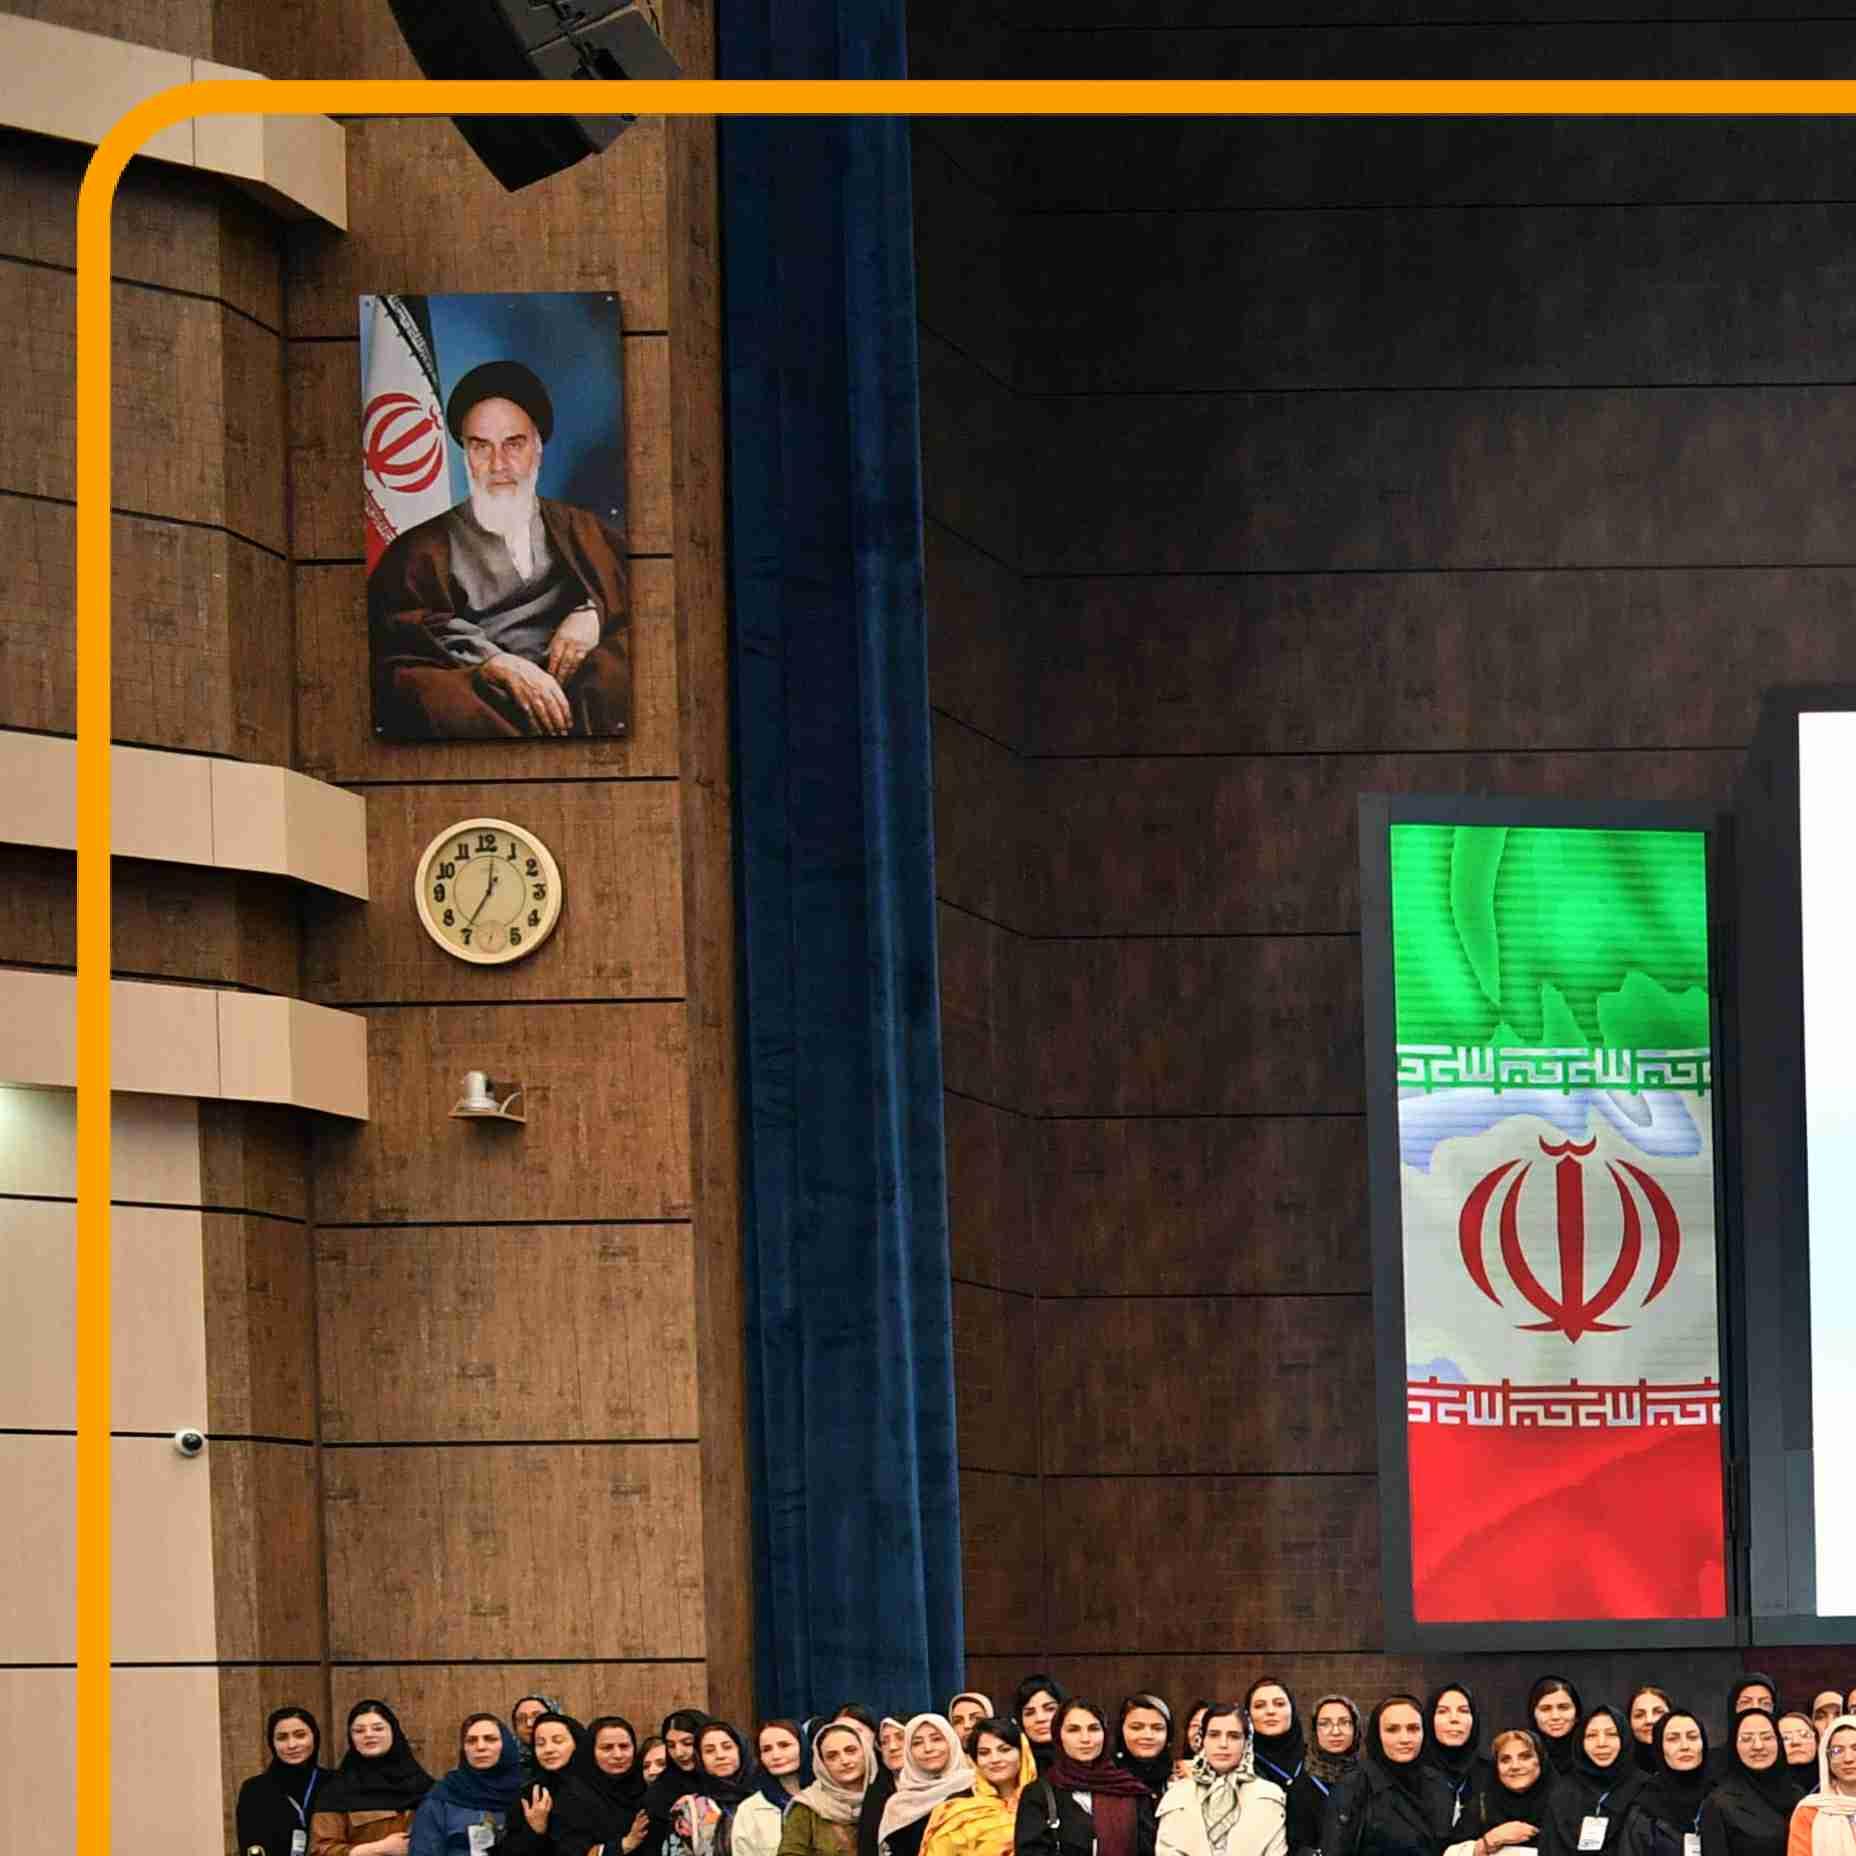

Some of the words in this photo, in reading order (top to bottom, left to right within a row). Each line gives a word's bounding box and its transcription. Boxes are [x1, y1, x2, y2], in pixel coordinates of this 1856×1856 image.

[454, 843, 470, 860] 11
[475, 834, 497, 852] 12
[508, 843, 516, 860] 1
[436, 862, 455, 880] 10
[526, 858, 538, 877] 2
[433, 883, 445, 902] 9
[533, 883, 546, 901] 3
[443, 909, 454, 927] 8
[527, 909, 540, 927] 4
[461, 928, 472, 945] 7
[510, 927, 521, 945] 5
